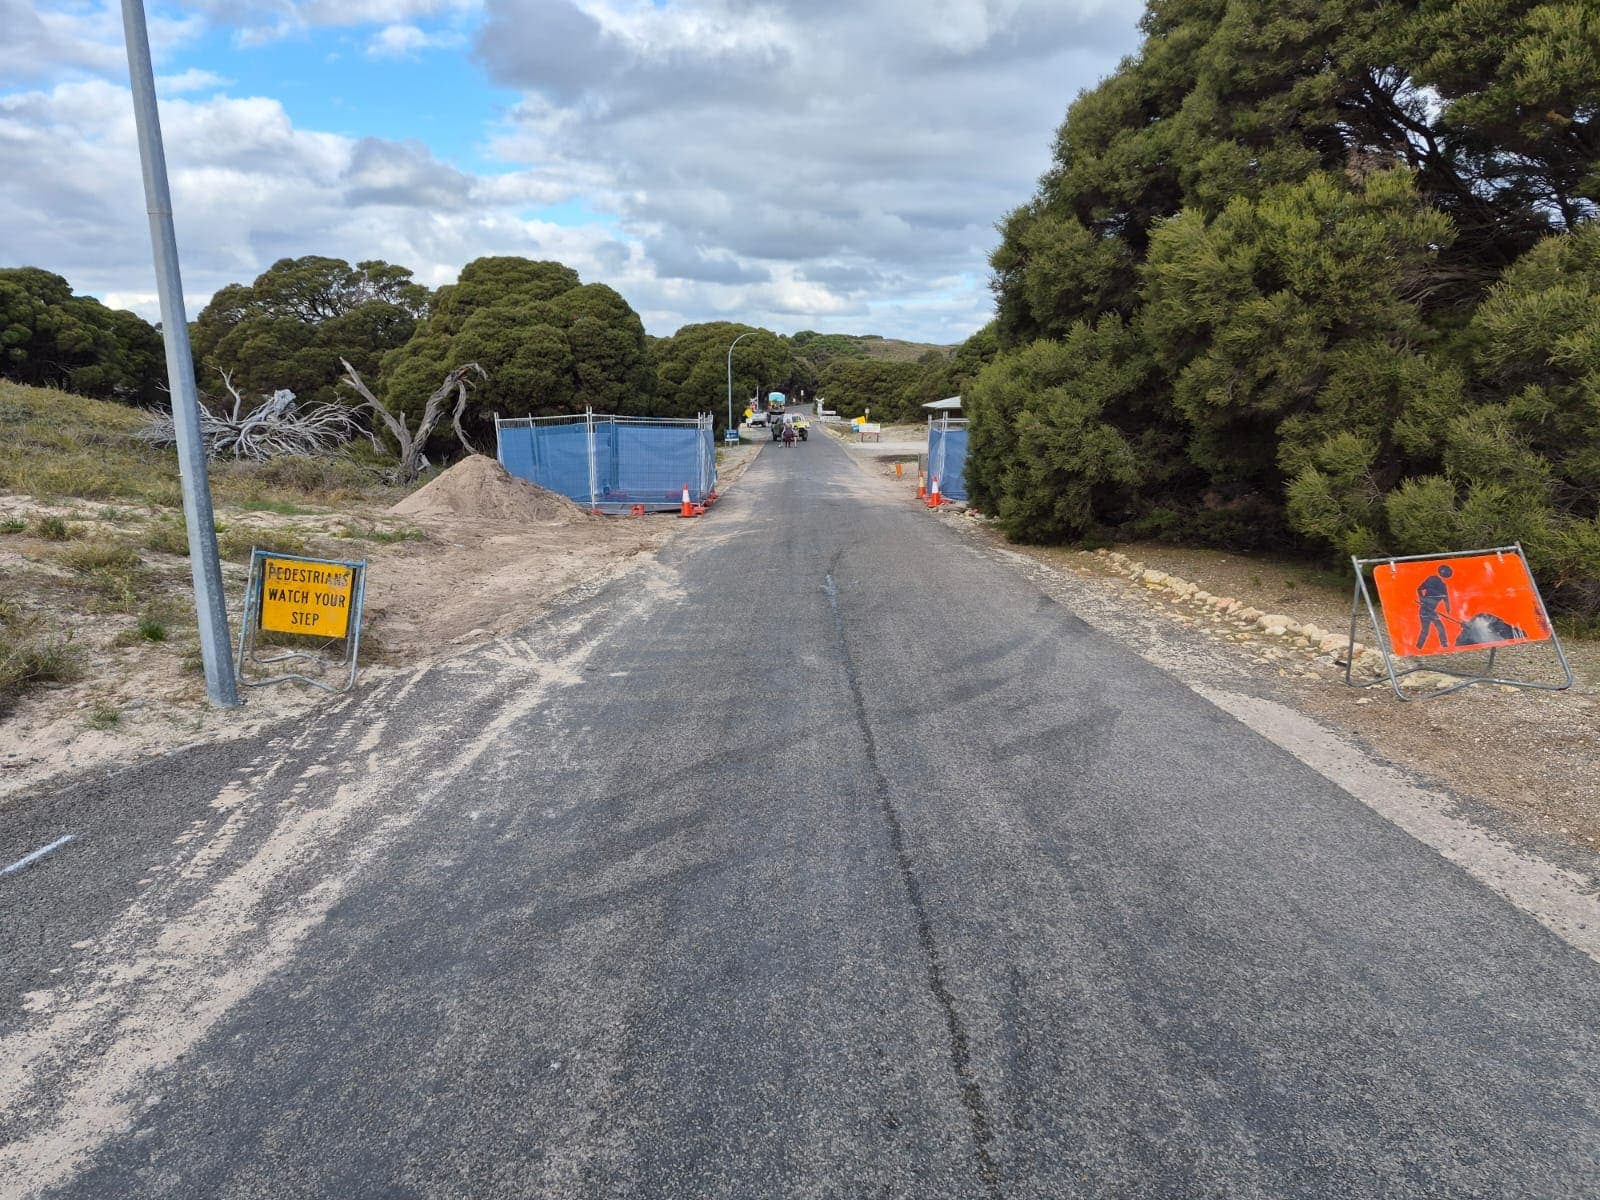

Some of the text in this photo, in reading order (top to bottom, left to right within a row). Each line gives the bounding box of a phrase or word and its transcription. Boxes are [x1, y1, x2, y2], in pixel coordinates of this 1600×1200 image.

[268, 566, 350, 587] PEDESTRIANS
[268, 588, 346, 608] WATCH YOUR
[291, 611, 320, 626] STEP
